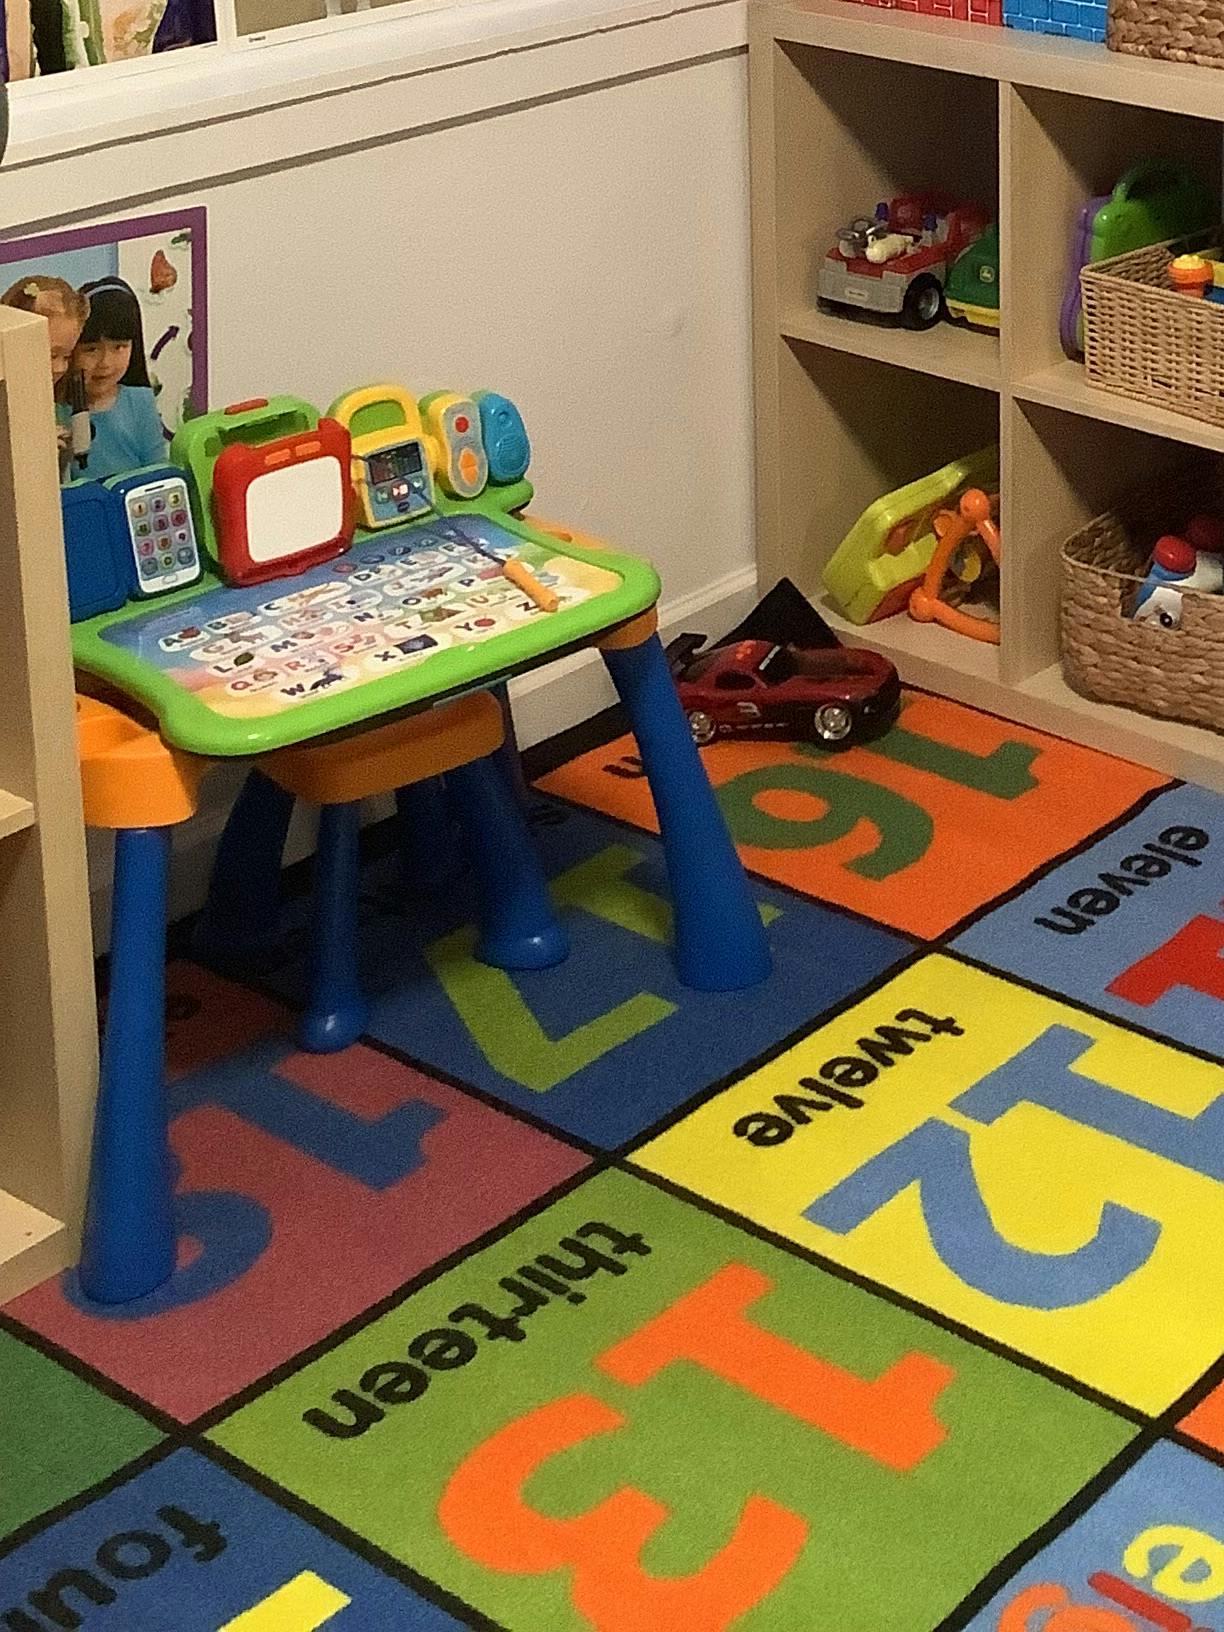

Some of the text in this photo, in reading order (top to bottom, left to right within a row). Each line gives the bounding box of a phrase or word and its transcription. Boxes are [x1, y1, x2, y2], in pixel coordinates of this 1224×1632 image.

[354, 572, 372, 582] D
[264, 602, 280, 611] C
[402, 597, 422, 606] O
[516, 601, 538, 612] Z
[353, 612, 375, 622] N
[454, 621, 474, 632] Y
[162, 637, 182, 647] A
[269, 639, 298, 653] M
[333, 643, 355, 653] S
[374, 650, 397, 662] X
[213, 665, 234, 674] L
[230, 681, 253, 691] Q
[280, 683, 306, 697] W
[712, 726, 1043, 883] 16
[1033, 824, 1210, 938] eleven
[732, 1006, 967, 1150] twelve
[302, 1219, 654, 1440] thirteen
[437, 1262, 957, 1632] 13
